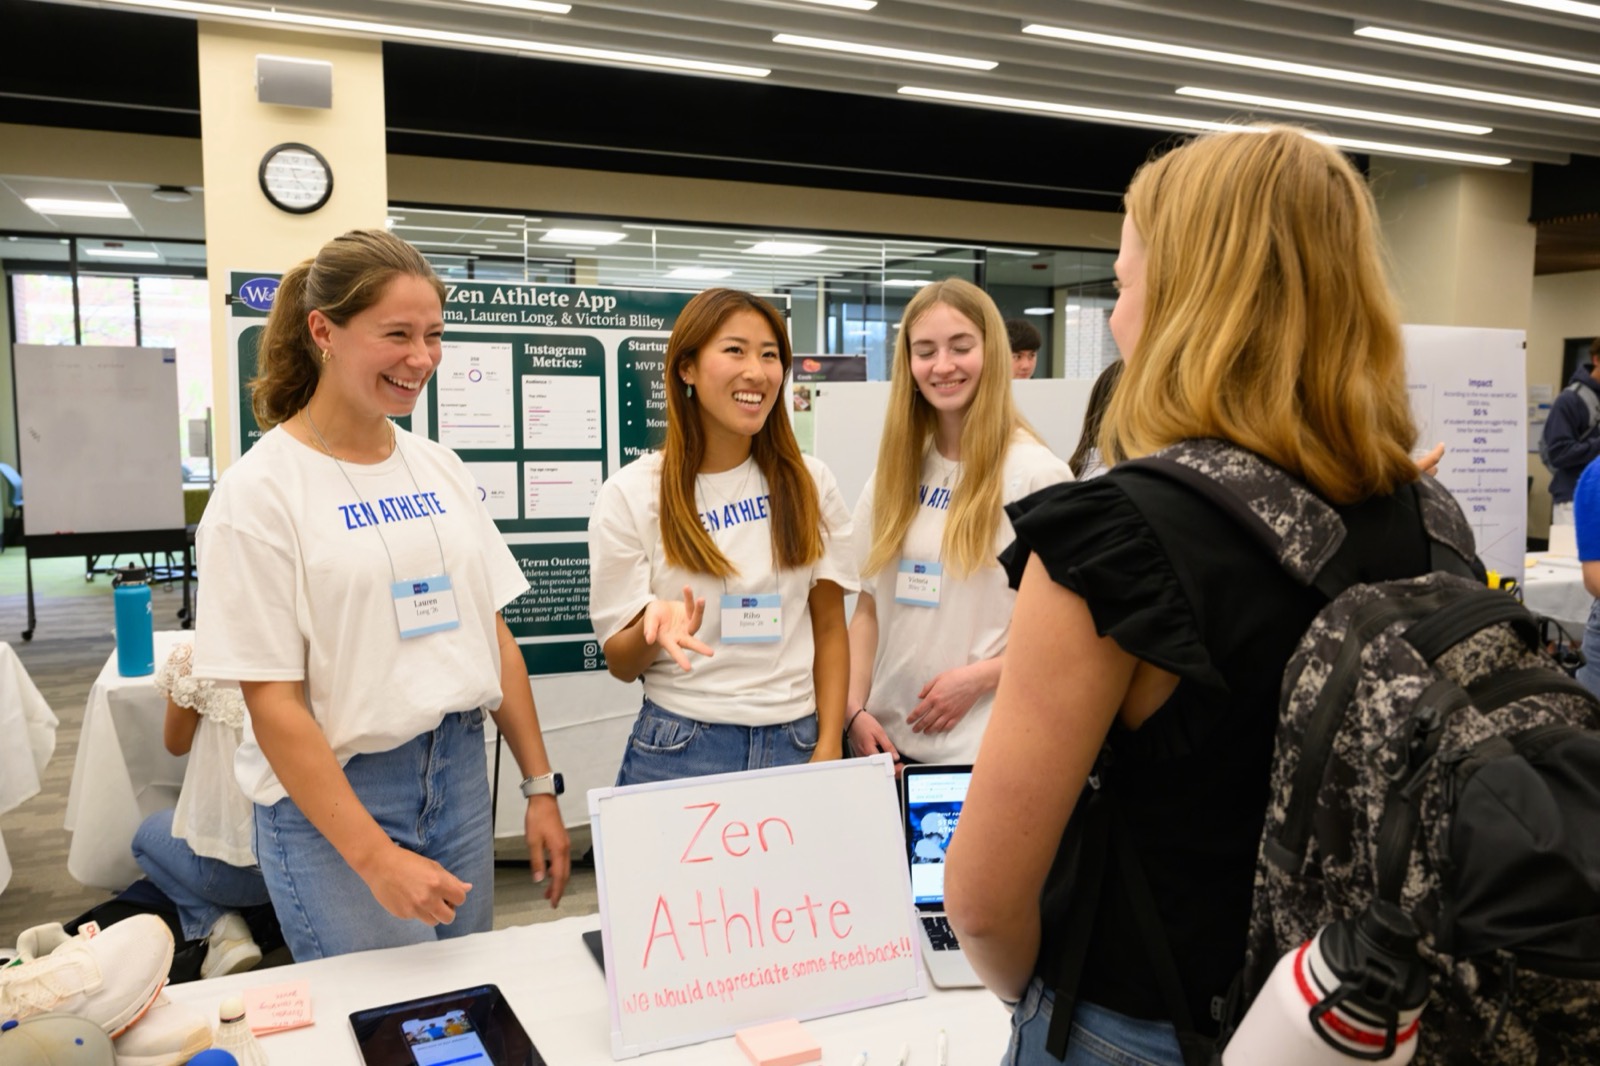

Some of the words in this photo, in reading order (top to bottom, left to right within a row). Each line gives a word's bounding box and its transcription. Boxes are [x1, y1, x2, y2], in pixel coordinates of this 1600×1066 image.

[445, 286, 485, 304] Zen
[490, 287, 570, 307] Athlete
[574, 291, 617, 312] App
[442, 310, 468, 322] ma,
[471, 309, 517, 323] Lauren
[521, 311, 557, 326] Long,
[561, 314, 573, 325] &
[576, 313, 626, 327] Victoria
[629, 315, 665, 330] Bliley
[524, 343, 587, 357] Instagram
[532, 356, 582, 368] Metrics:
[635, 362, 656, 371] MVP
[646, 400, 668, 409] Empl
[646, 419, 668, 427] Mone
[927, 487, 951, 510] ATH
[338, 502, 380, 530] ZEN
[378, 492, 446, 523] ATHLETE
[723, 494, 771, 528] ATHLE
[521, 558, 548, 567] Term
[551, 557, 590, 566] Outcom
[551, 569, 572, 577] using
[540, 578, 576, 587] improved
[549, 586, 573, 594] better
[414, 598, 438, 608] Lauren
[537, 596, 565, 604] Athlete
[504, 606, 520, 615] how
[553, 605, 570, 613] past
[937, 818, 958, 827] STRO
[680, 802, 795, 863] Zen
[643, 887, 853, 969] Athlete
[654, 979, 704, 1007] would
[706, 963, 790, 1003] appreciate
[791, 955, 827, 977] some
[828, 937, 913, 971] feedback!!
